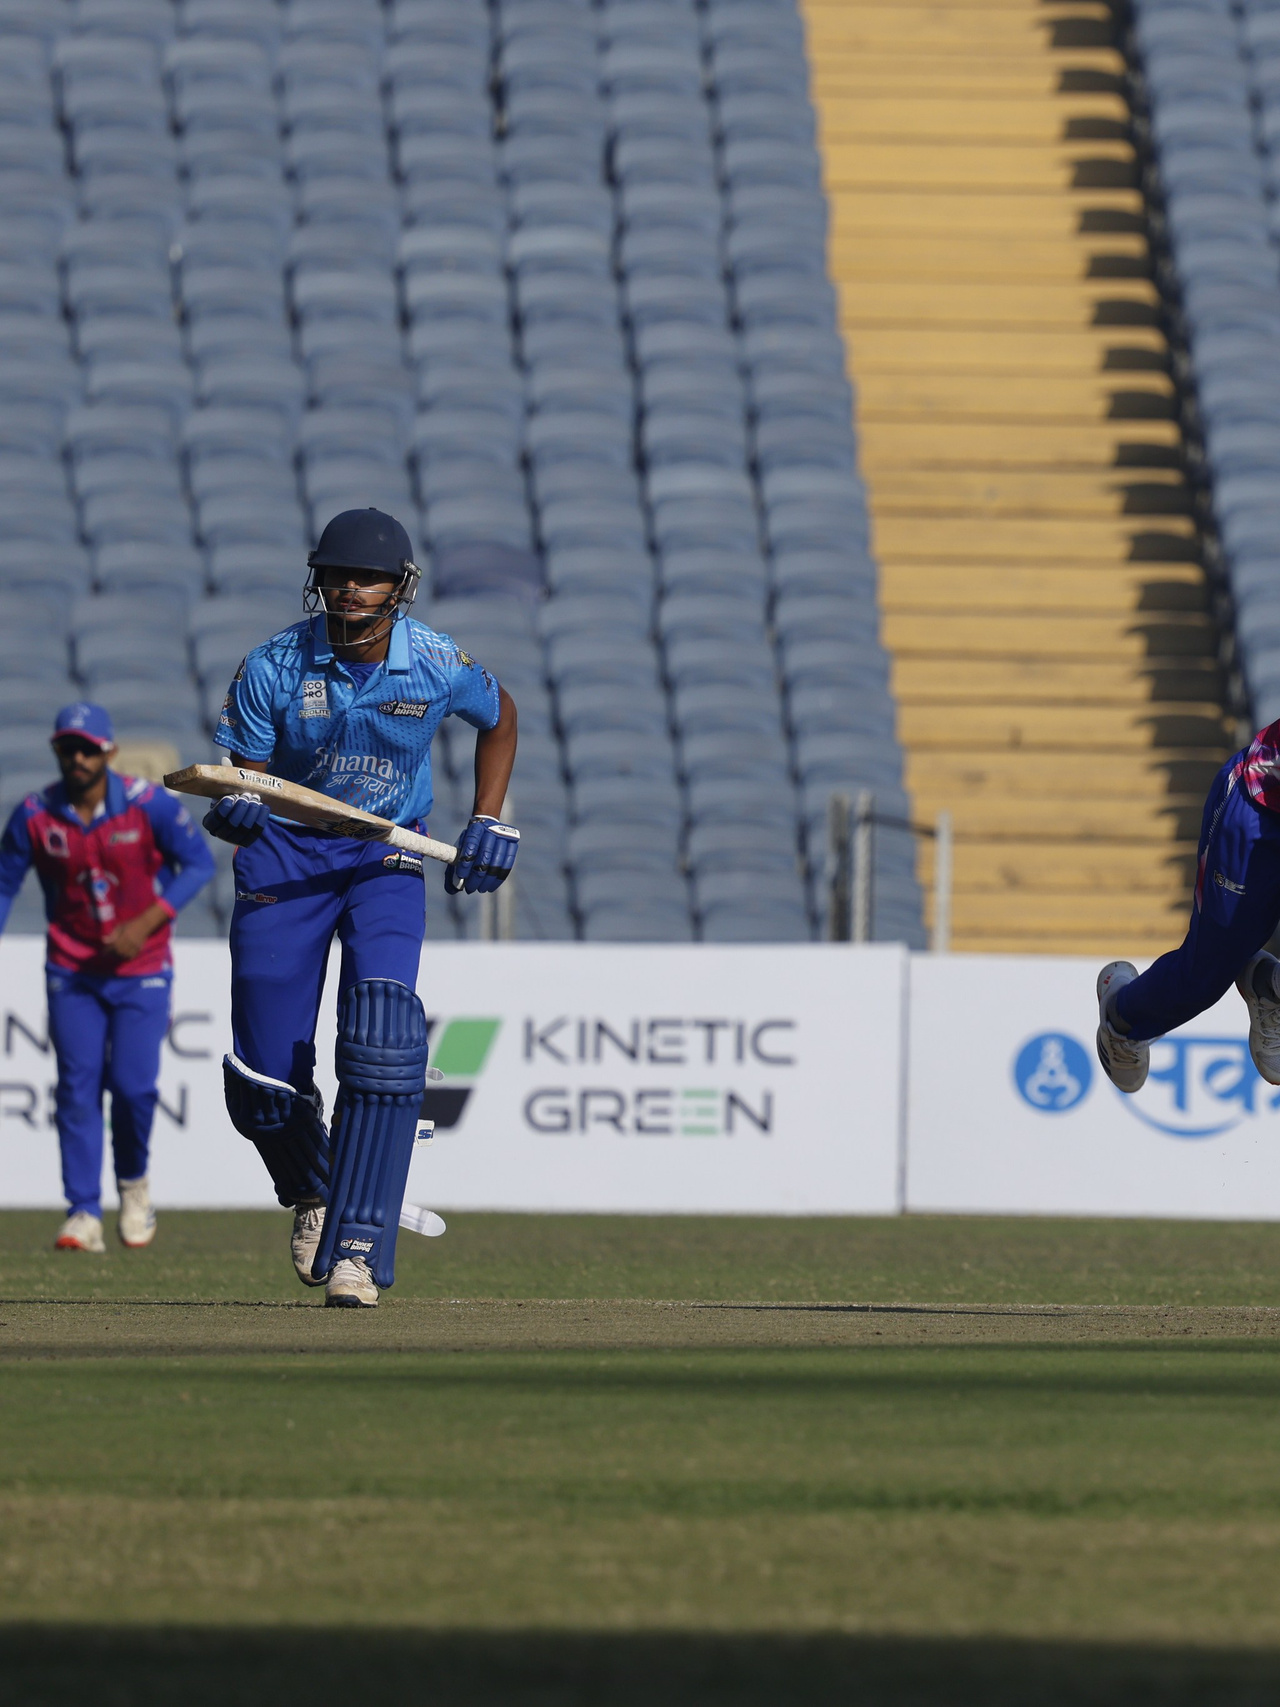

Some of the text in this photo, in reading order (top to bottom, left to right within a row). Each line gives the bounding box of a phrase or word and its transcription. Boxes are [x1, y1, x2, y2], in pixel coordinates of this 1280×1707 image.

[394, 708, 424, 718] BAPPA
[398, 702, 428, 711] PUNERI
[315, 742, 393, 780] Suhana
[524, 1017, 795, 1065] KINETIC
[524, 1088, 774, 1134] GREEN
